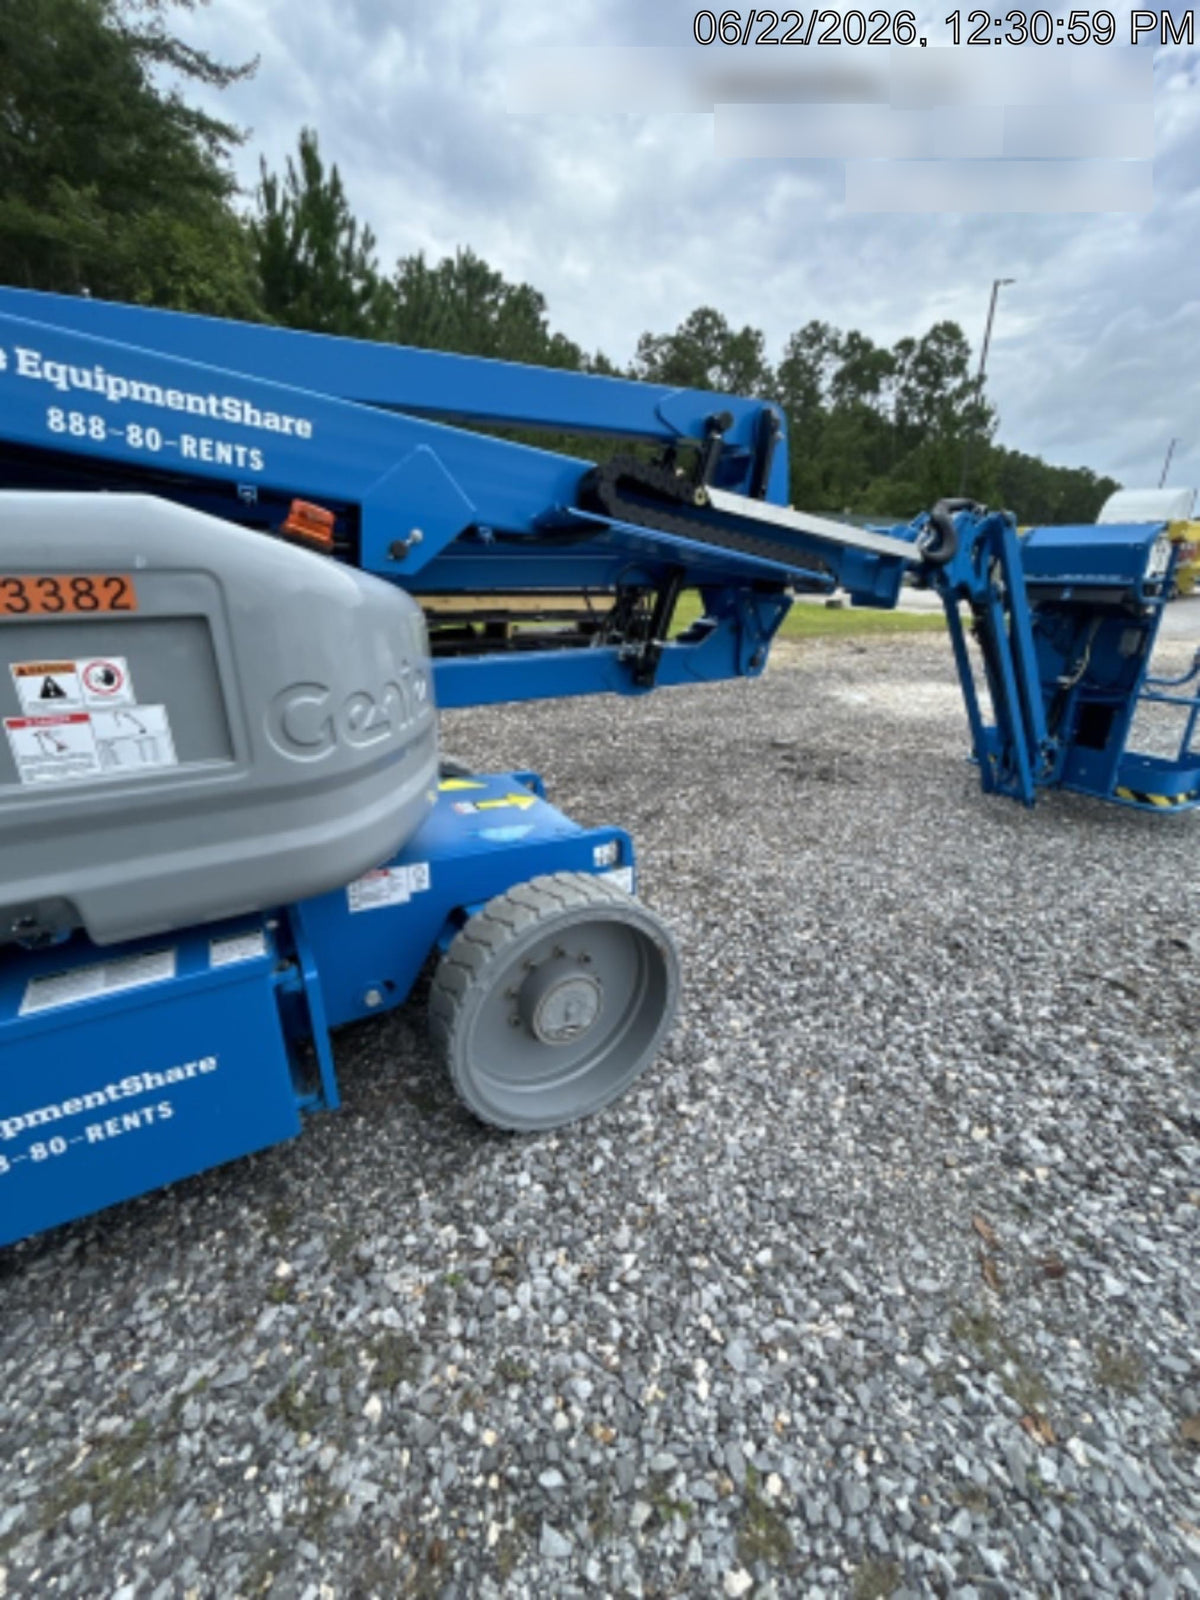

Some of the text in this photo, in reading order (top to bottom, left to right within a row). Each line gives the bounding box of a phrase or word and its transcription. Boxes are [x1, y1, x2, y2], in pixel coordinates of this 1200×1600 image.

[14, 347, 313, 439] EquipmentShare
[47, 406, 265, 471] 888-80-RENTS
[0, 575, 131, 613] 3382
[0, 1054, 218, 1139] pmentShare
